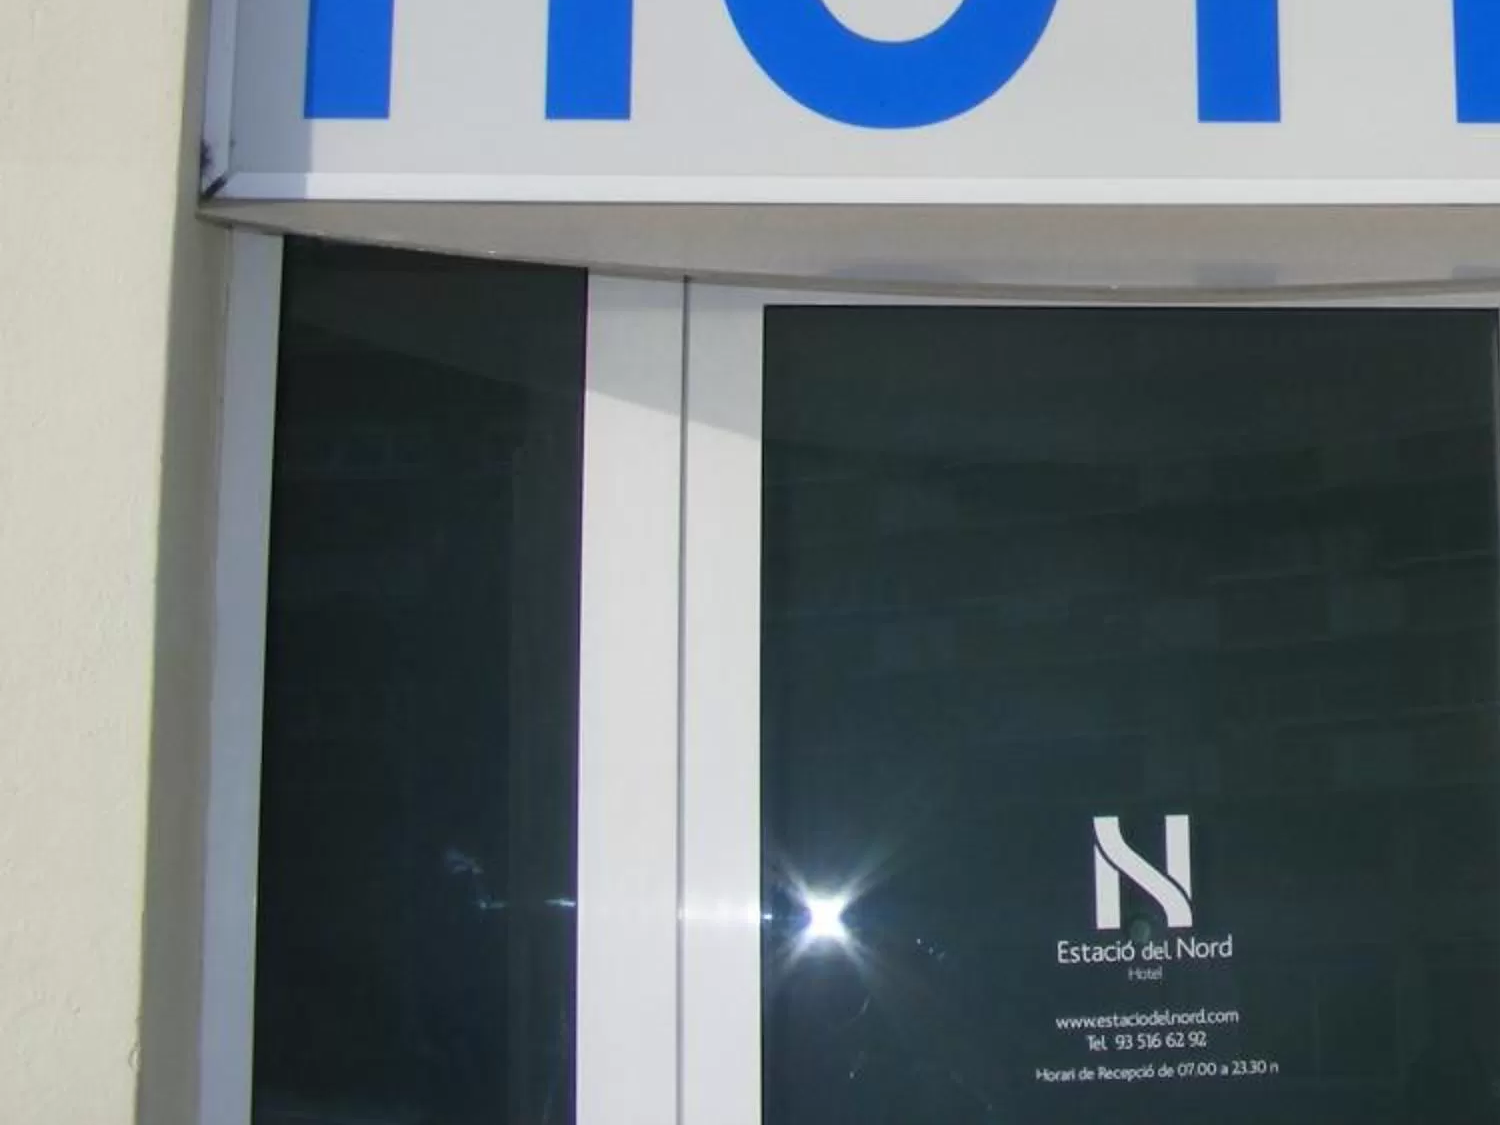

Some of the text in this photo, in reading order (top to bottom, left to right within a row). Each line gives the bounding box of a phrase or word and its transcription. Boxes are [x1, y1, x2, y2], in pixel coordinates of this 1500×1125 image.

[1057, 933, 1233, 964] Estació del Nord
[1127, 966, 1163, 981] Hotel
[1055, 1008, 1239, 1029] www.estaciodelnord.com
[1115, 1034, 1133, 1050] 93
[1137, 1032, 1161, 1049] 516
[1165, 1031, 1185, 1048] 62
[1187, 1030, 1207, 1048] 92
[1035, 1067, 1076, 1082] Horari
[1078, 1066, 1095, 1081] de
[1097, 1063, 1155, 1082] Recepció
[1157, 1062, 1175, 1078] de
[1220, 1064, 1230, 1076] a
